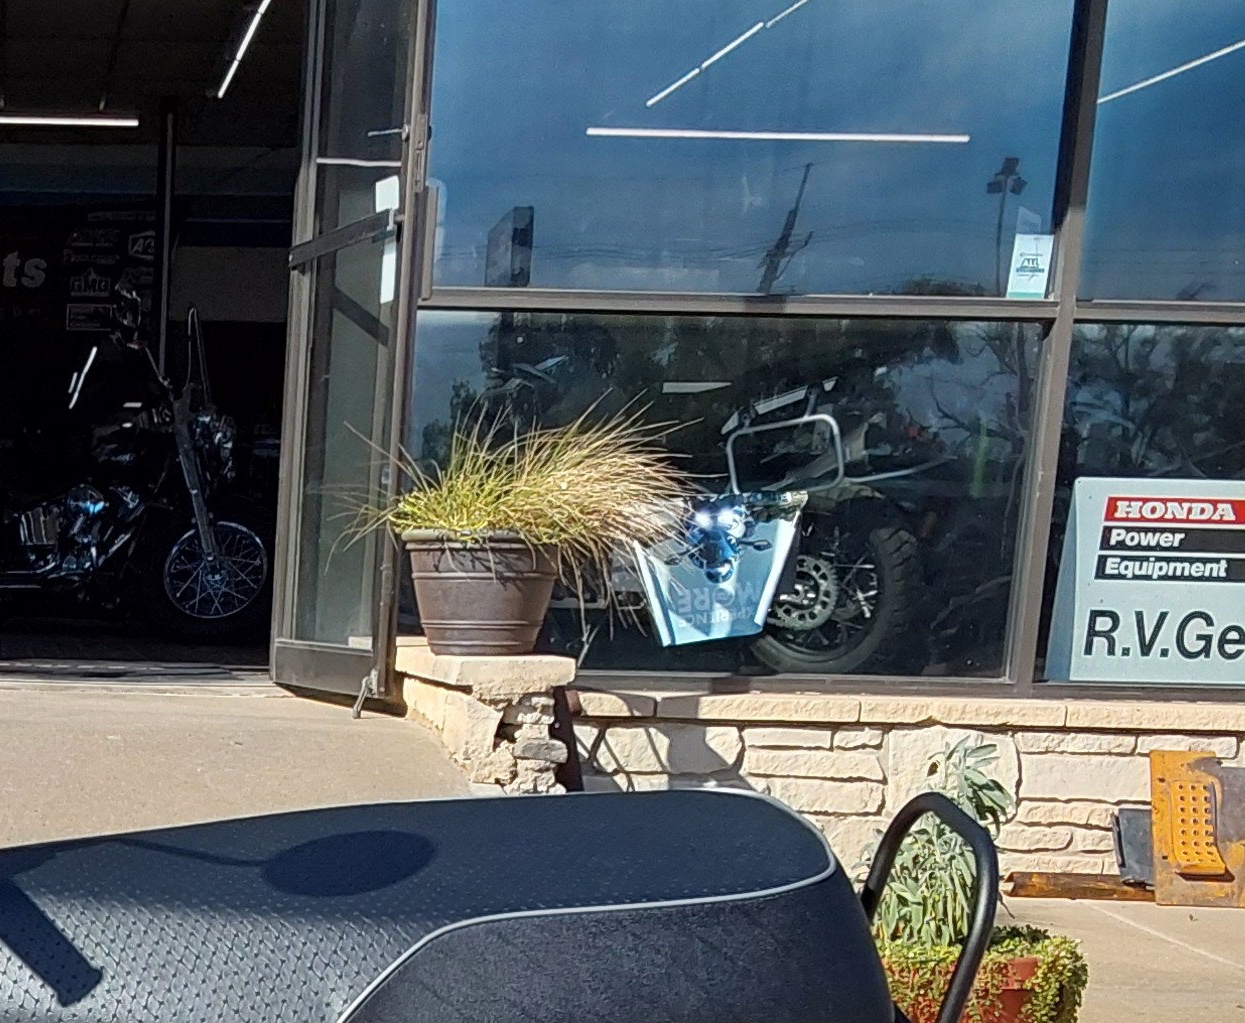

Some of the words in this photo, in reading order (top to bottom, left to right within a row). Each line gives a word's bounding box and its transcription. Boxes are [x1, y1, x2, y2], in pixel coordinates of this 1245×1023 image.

[1113, 500, 1236, 520] HONDA
[1109, 528, 1185, 548] Power
[1104, 557, 1228, 579] Equipment
